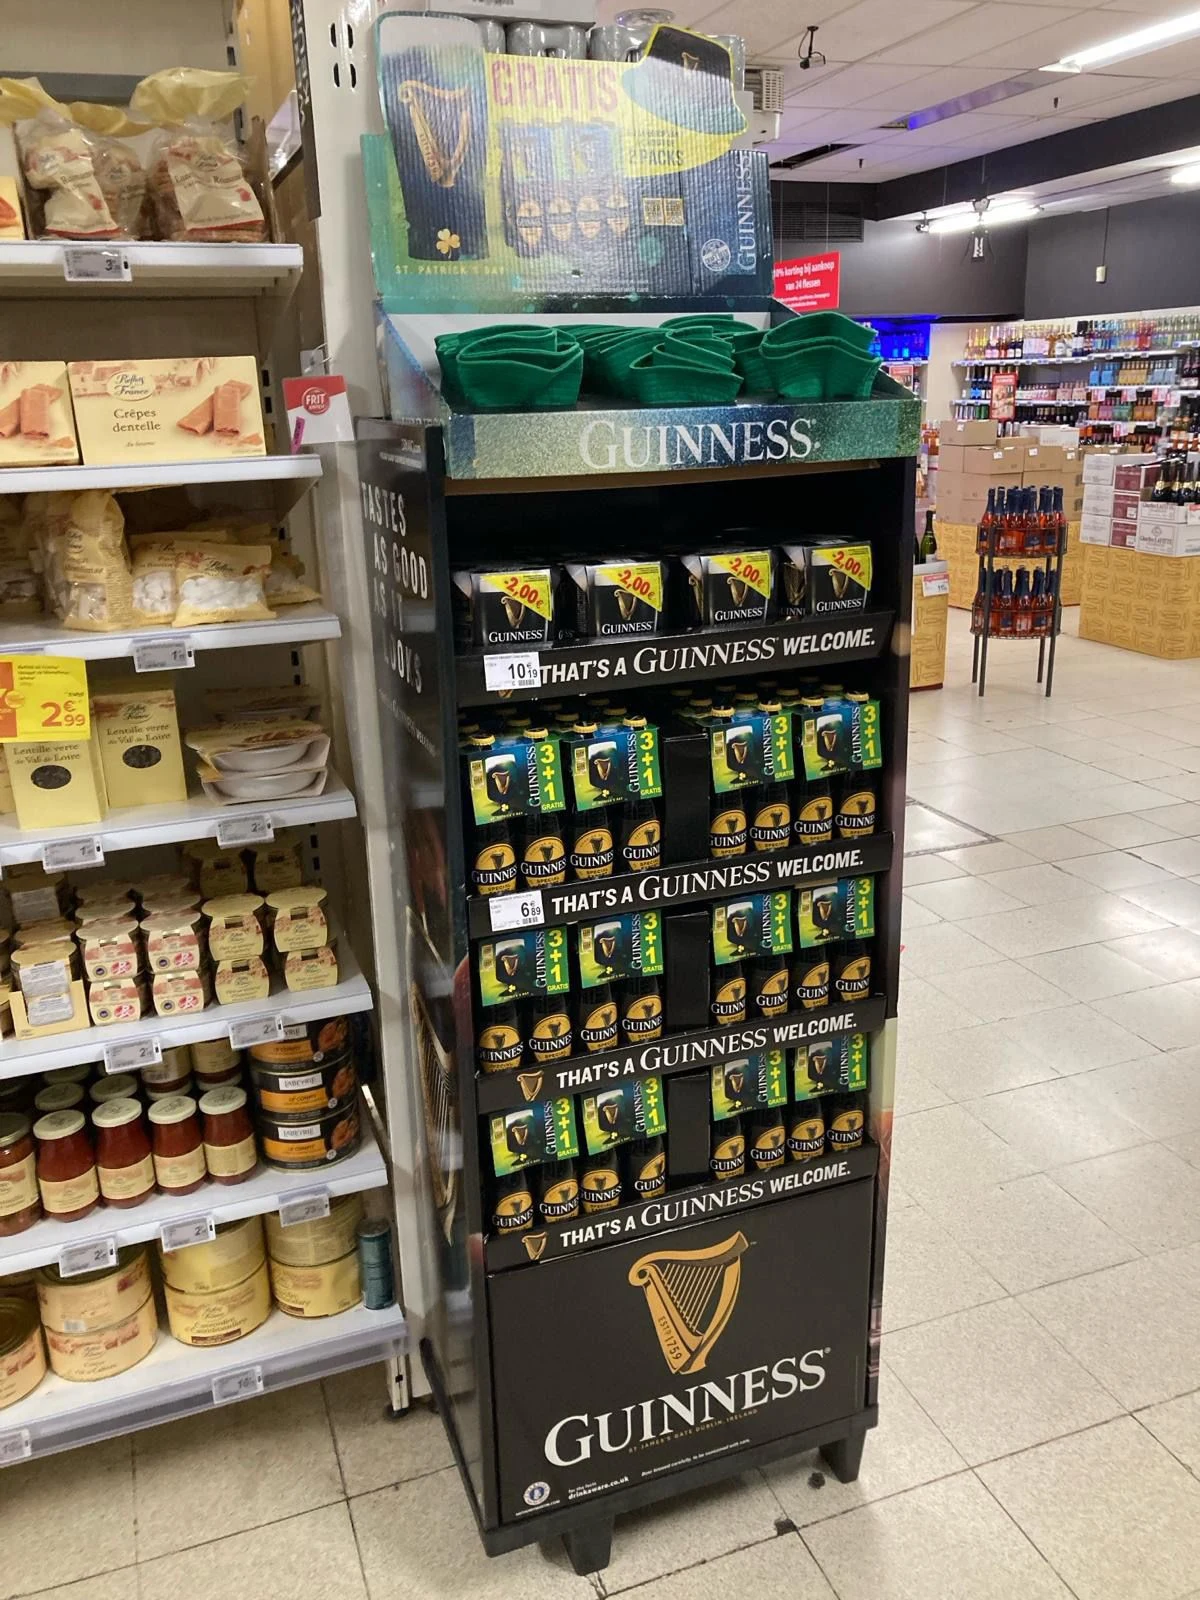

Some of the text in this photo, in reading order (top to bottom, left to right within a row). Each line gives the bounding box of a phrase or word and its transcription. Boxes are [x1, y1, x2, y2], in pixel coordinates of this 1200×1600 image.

[491, 60, 620, 112] GRATIS
[735, 150, 756, 270] GUINNESS
[785, 265, 803, 276] korting
[812, 261, 834, 272] aankoop
[803, 279, 820, 288] flessen
[306, 393, 326, 405] FRIT
[113, 408, 156, 420] Crêpes
[112, 421, 161, 432] dentelle
[580, 417, 819, 469] GUINNESS
[360, 480, 406, 537] TASTES
[392, 541, 428, 600] GOOD
[714, 607, 764, 621] GUINNESS
[816, 599, 863, 613] GUINNESS
[488, 629, 544, 643] GUINNESS
[602, 621, 654, 635] GUINNESS
[540, 628, 875, 685] THAT'S A GUINNESS WELCOME.
[41, 702, 62, 728] 2
[64, 714, 86, 727] 99
[863, 705, 876, 723] 3
[774, 716, 788, 735] 3
[640, 732, 654, 750] 3
[865, 740, 875, 758] 1
[540, 744, 556, 764] 3
[628, 733, 641, 793] GUINNESS
[777, 751, 788, 770] 1
[526, 746, 542, 808] GUINNESS
[644, 768, 654, 786] 1
[544, 782, 556, 802] 1
[640, 786, 662, 796] GRATIS
[541, 801, 564, 812] GRATIS
[552, 850, 864, 916] THAT'S A GUINNESS WELCOME.
[858, 878, 870, 895] 3
[774, 893, 788, 910] 3
[644, 912, 658, 930] 3
[858, 911, 868, 928] 1
[548, 929, 562, 947] 3
[774, 926, 786, 944] 1
[536, 931, 546, 988] GUINNESS
[646, 946, 656, 964] 1
[550, 964, 562, 982] 1
[556, 1013, 858, 1089] THAT'S A GUINNESS WELCOME.
[852, 1034, 864, 1050] 3
[770, 1050, 782, 1066] 3
[852, 1064, 862, 1080] 1
[646, 1078, 658, 1094] 3
[771, 1081, 780, 1097] 1
[556, 1098, 570, 1116] 3
[648, 1109, 659, 1126] 1
[544, 1100, 556, 1154] GUINNESS
[560, 1131, 570, 1148] 1
[560, 1162, 851, 1247] THAT'S A GUINNESS WELCOME.
[664, 1336, 682, 1360] 1759
[544, 1349, 828, 1466] GUINNESS
[568, 1476, 630, 1500] drinkaware.co.uk
